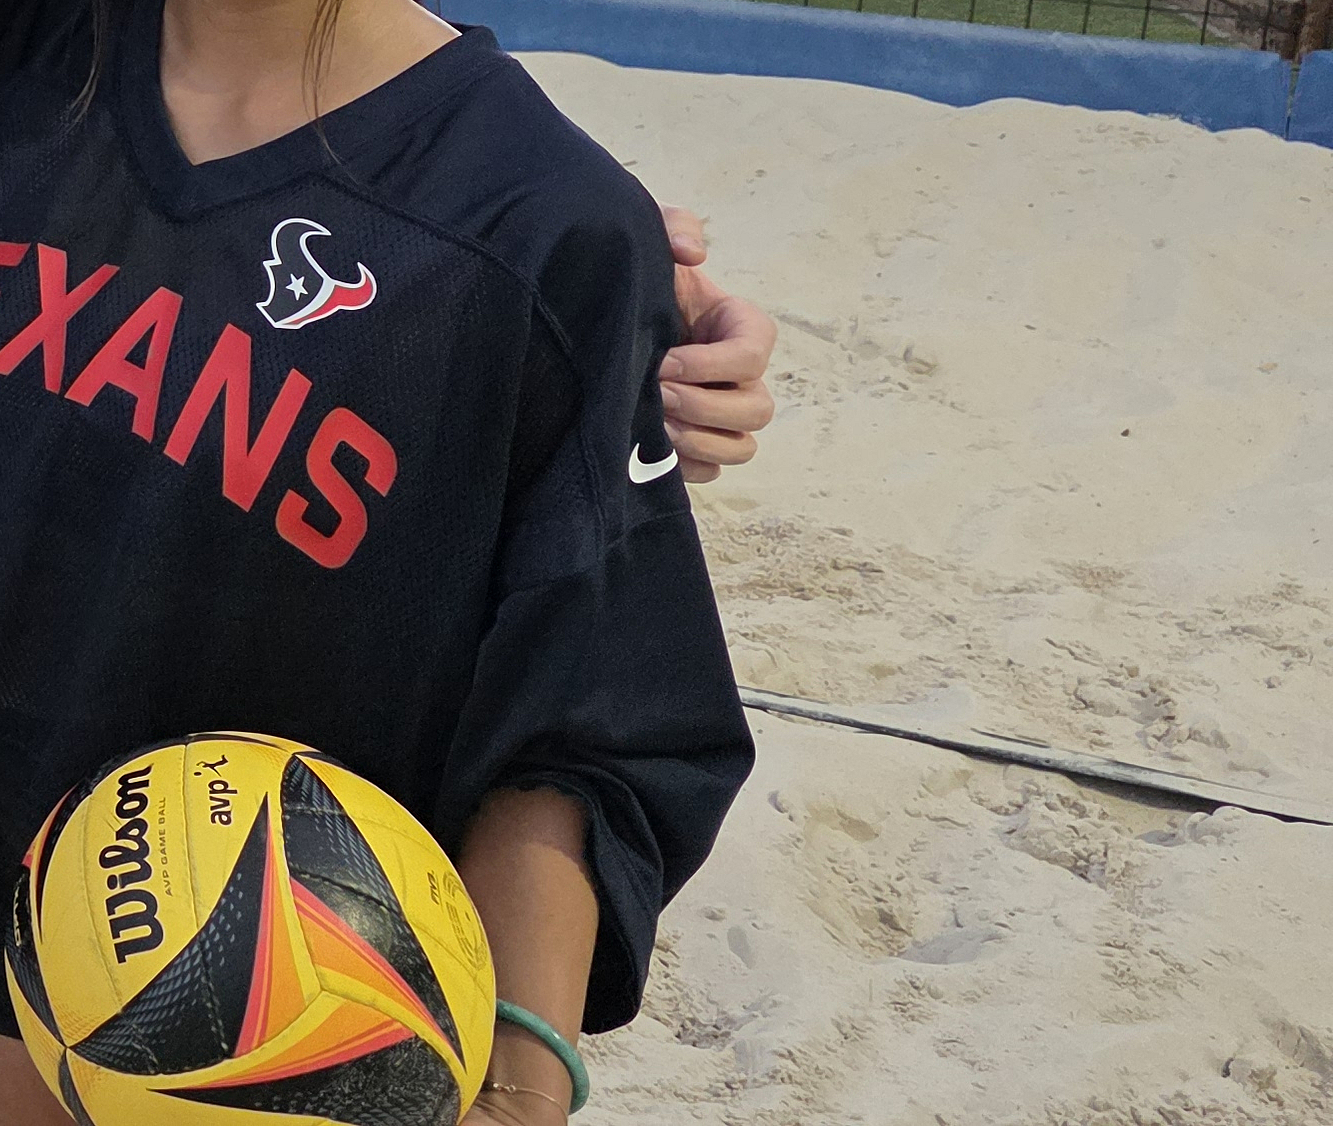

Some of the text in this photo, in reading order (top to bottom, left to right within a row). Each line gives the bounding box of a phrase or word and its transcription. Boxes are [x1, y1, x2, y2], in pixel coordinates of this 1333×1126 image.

[157, 796, 173, 897] AVP GAME BALL
[207, 779, 238, 826] avp
[99, 763, 164, 964] Wilson
